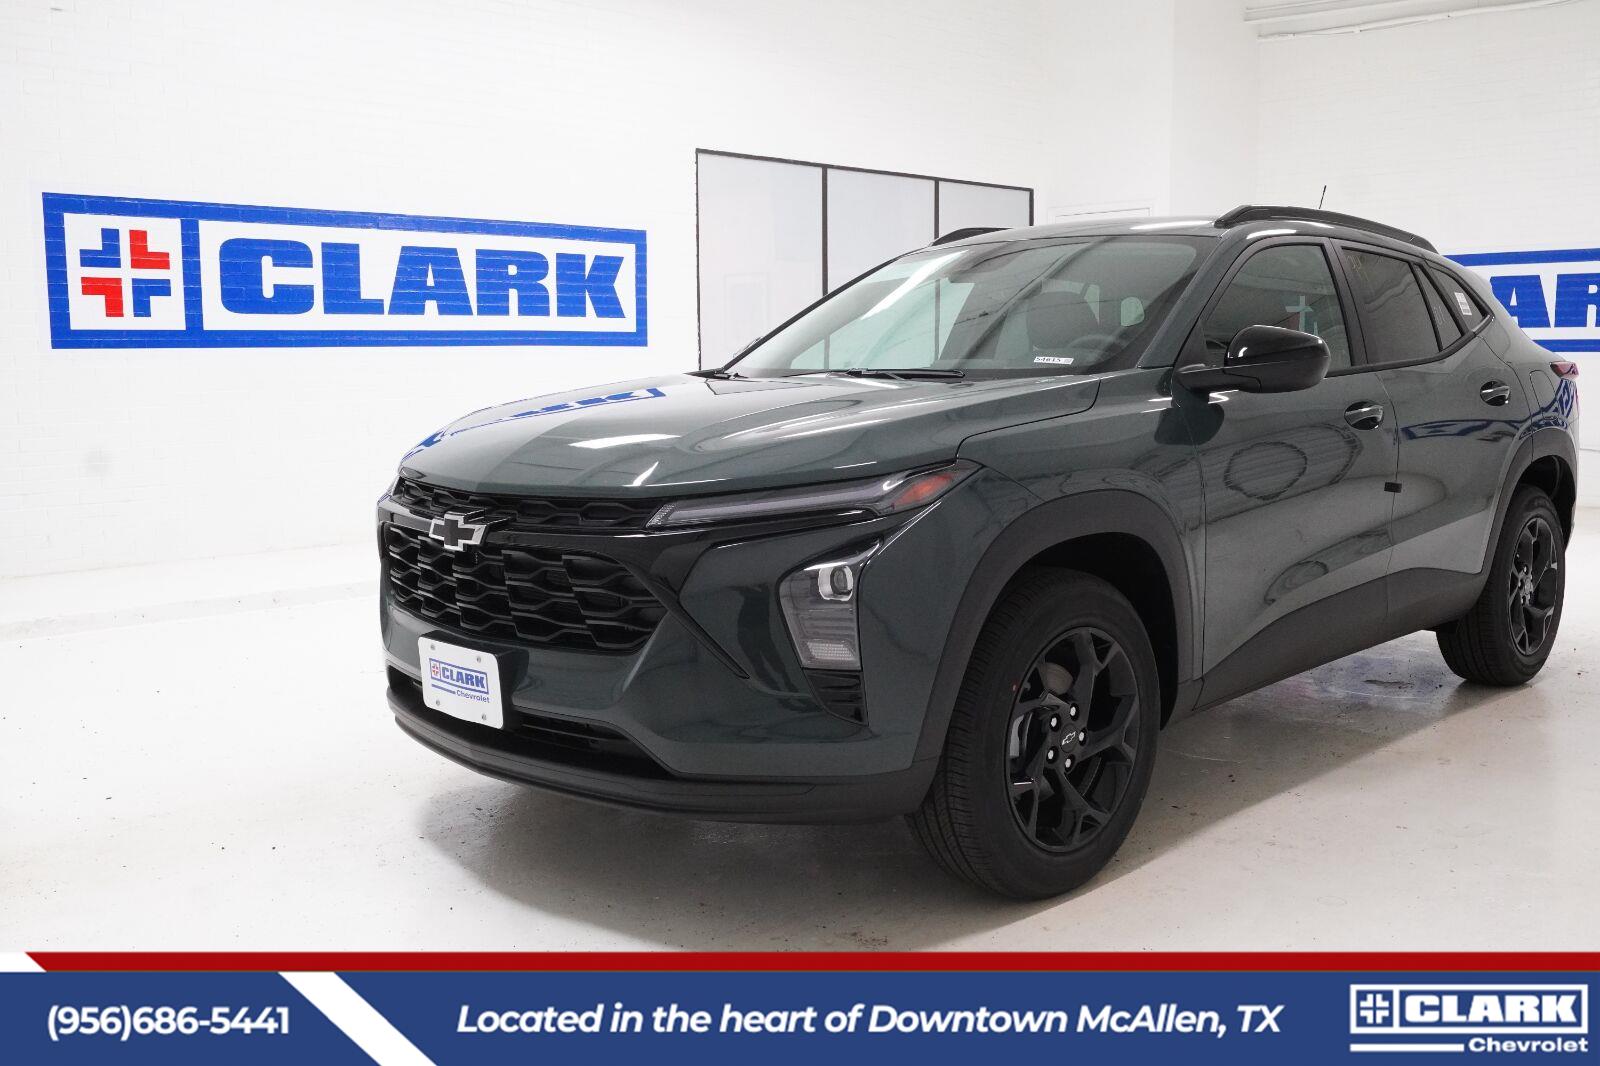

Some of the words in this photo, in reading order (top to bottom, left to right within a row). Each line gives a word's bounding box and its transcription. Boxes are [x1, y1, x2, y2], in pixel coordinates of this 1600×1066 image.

[219, 237, 626, 319] CLARK
[441, 667, 485, 689] CLARK
[456, 689, 490, 703] Chevrolet
